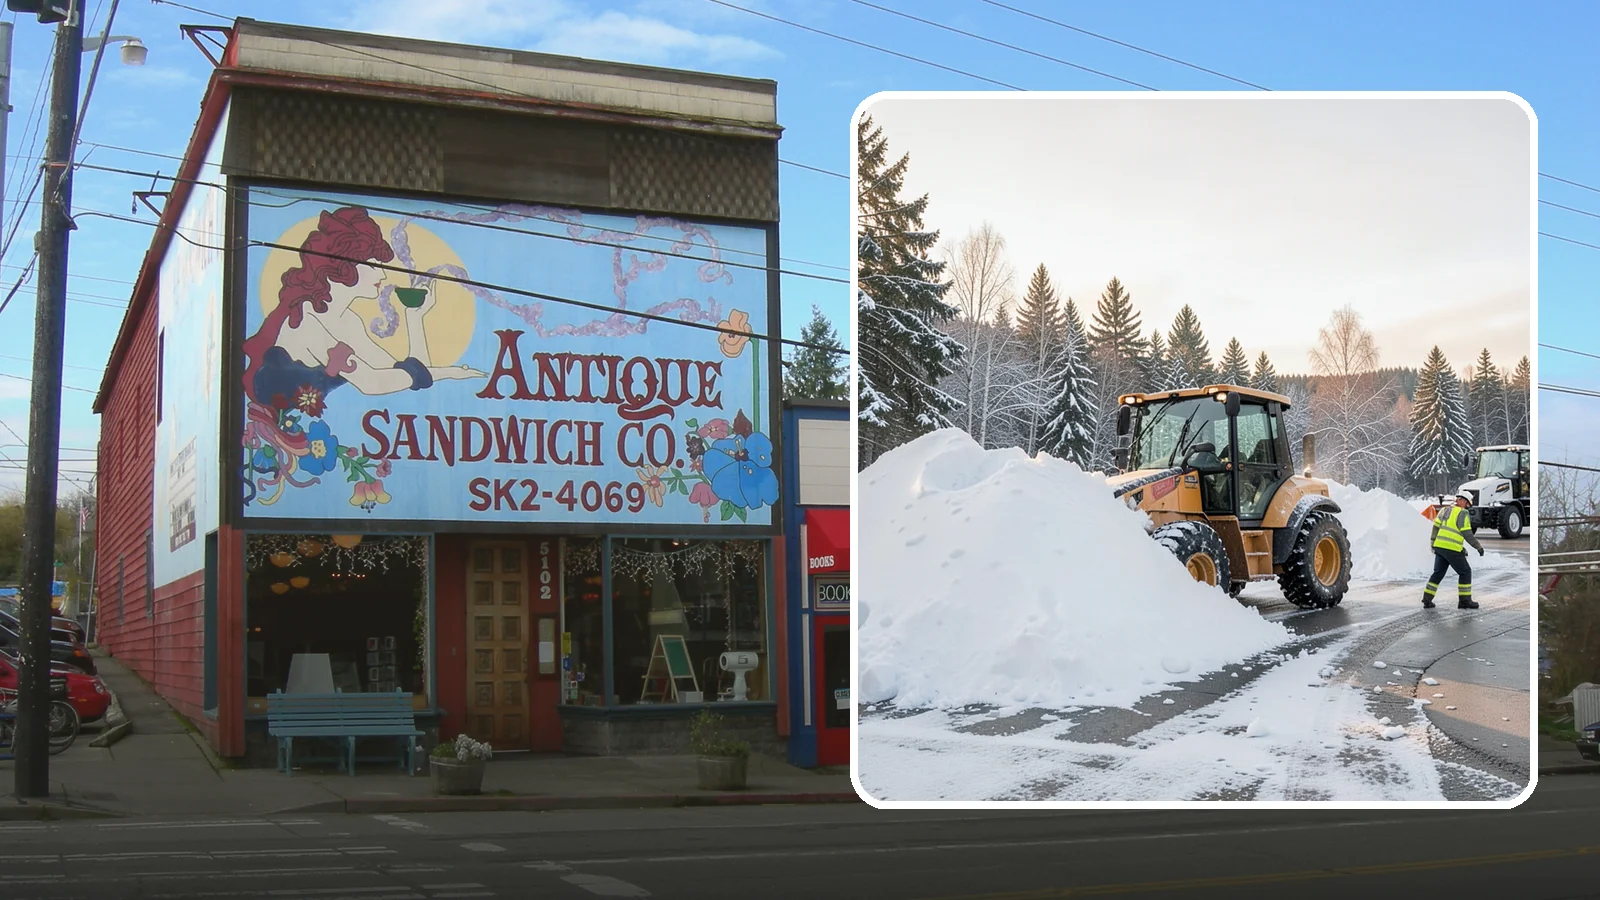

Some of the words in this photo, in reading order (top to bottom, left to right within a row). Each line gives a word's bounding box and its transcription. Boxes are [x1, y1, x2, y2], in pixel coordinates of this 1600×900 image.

[475, 328, 724, 420] ANTIQUE
[361, 409, 604, 467] SANDWICH
[617, 422, 684, 468] CO.
[469, 478, 645, 511] SK2-4069
[540, 542, 551, 599] 5102
[809, 555, 834, 568] BOOKS
